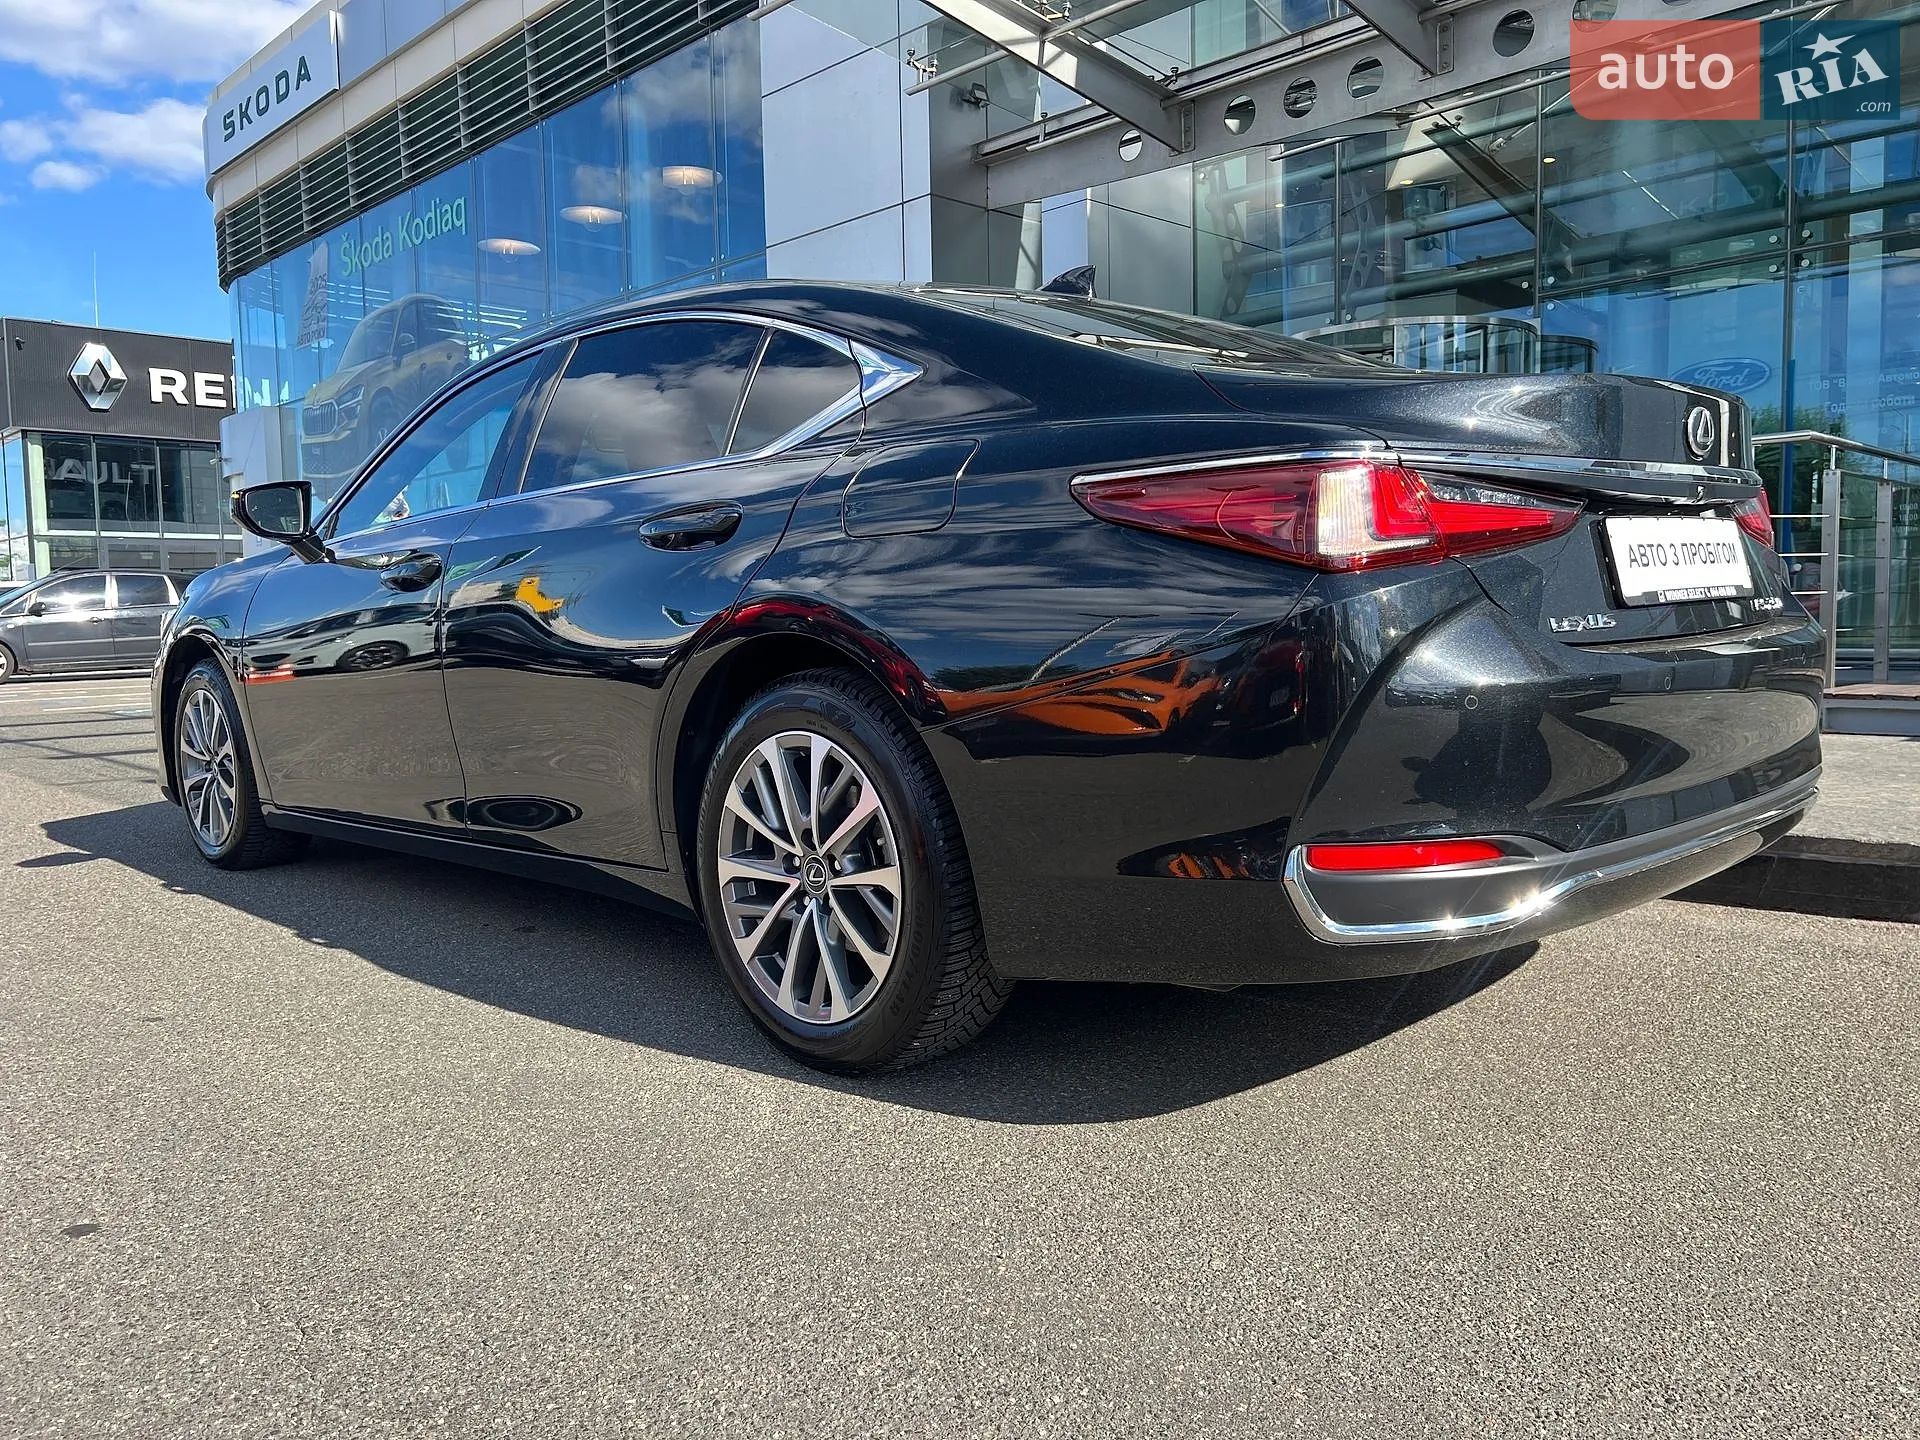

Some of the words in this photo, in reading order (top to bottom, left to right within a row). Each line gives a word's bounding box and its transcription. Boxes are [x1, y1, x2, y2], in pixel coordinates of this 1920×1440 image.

[340, 226, 394, 278] Škoda
[398, 196, 468, 250] Kodiaq
[1692, 365, 1751, 388] Ford
[1628, 543, 1668, 568] АВТО
[1681, 542, 1739, 565] ПРОБІГОМ
[1548, 613, 1618, 633] LEXUS
